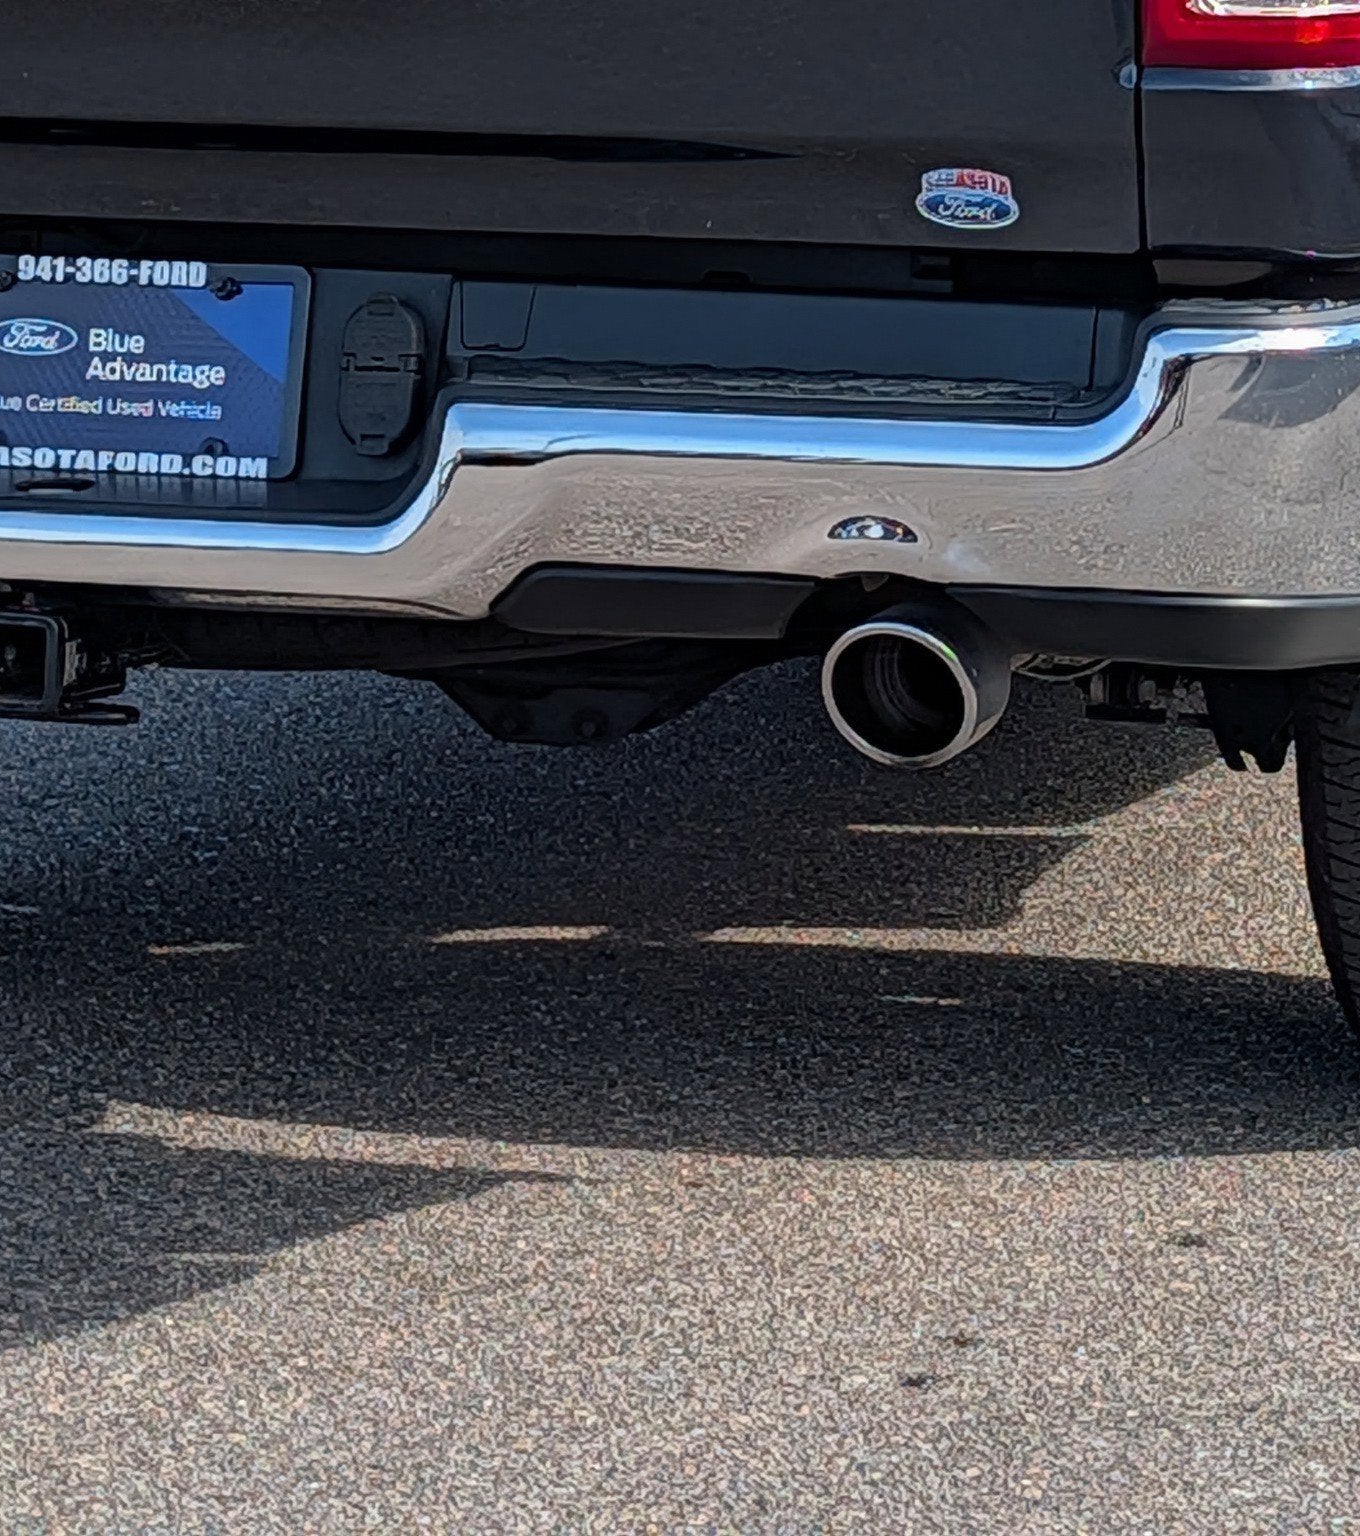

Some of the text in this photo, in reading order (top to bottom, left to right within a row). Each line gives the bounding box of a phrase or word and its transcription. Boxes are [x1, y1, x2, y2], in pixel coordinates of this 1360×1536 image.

[17, 254, 208, 288] 941-366-FORD
[2, 322, 61, 350] Ford
[88, 327, 145, 354] Blue
[86, 356, 226, 390] Advantage
[26, 393, 102, 414] Certified
[106, 396, 154, 417] Used
[157, 400, 222, 421] Vehicle
